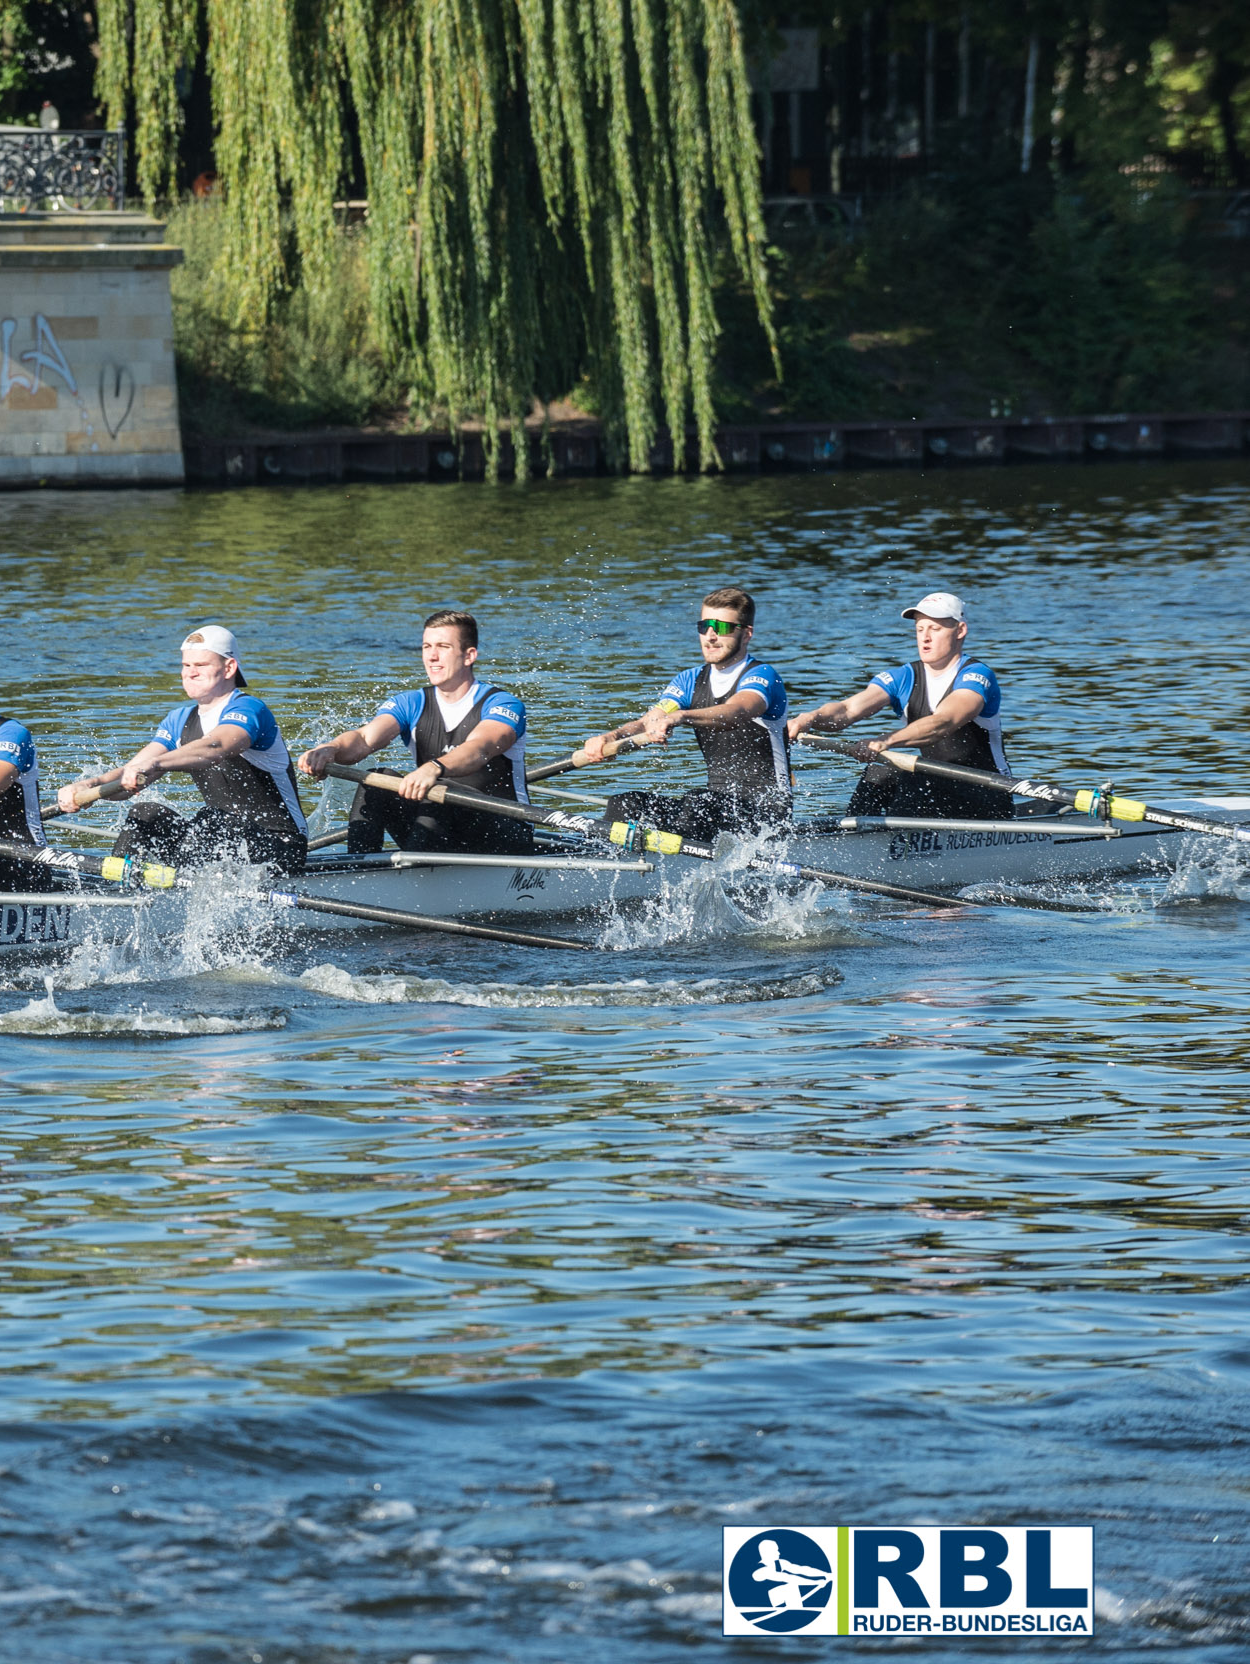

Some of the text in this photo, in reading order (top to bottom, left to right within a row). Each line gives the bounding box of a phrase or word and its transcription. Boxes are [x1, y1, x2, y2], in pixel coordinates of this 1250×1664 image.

[501, 708, 519, 722] RBL
[0, 742, 20, 755] RBL
[909, 831, 942, 852] RBL
